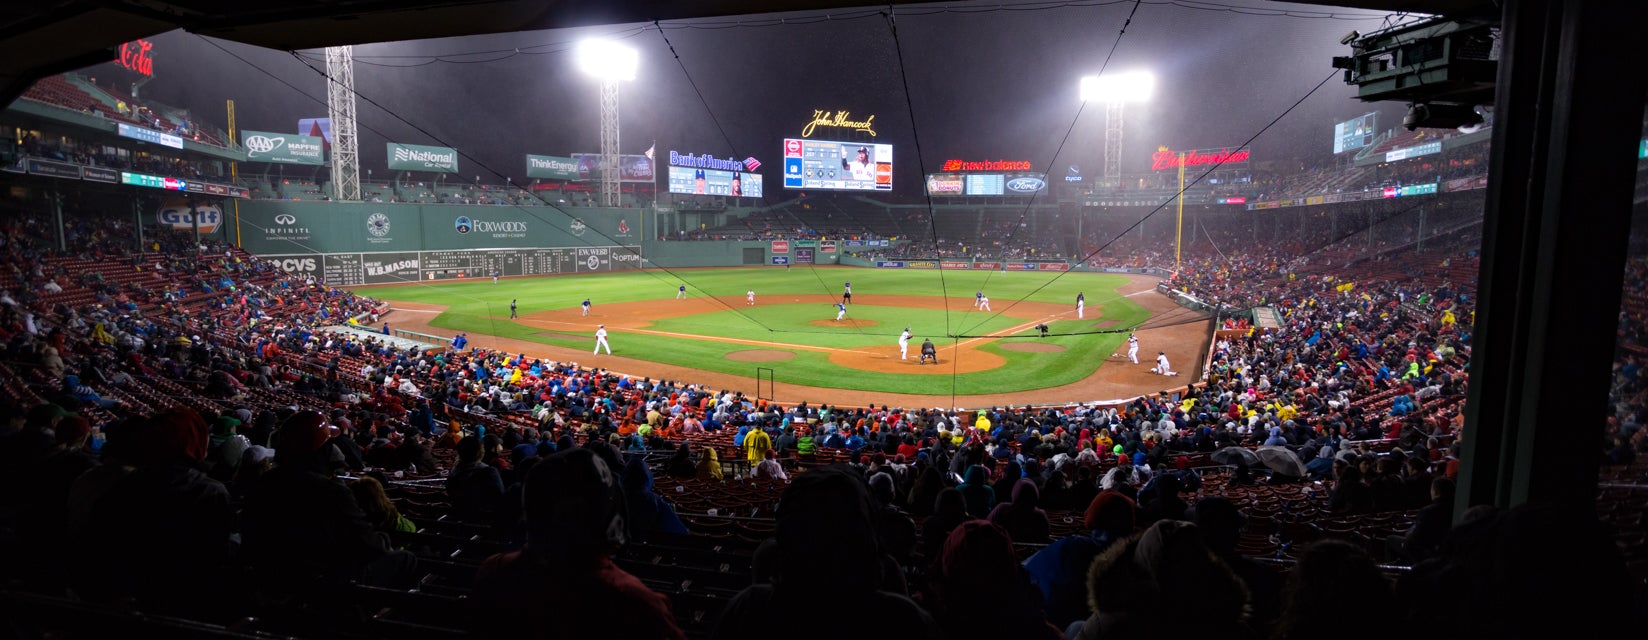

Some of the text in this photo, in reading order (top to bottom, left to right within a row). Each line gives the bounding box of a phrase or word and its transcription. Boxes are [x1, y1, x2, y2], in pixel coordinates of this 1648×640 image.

[802, 109, 876, 137] John Hancock
[409, 150, 452, 163] National
[670, 150, 743, 171] Bank of America
[1152, 147, 1250, 171] Budweiser
[530, 158, 578, 173] ThinkEnergy
[962, 159, 1031, 170] new balance
[1014, 179, 1037, 190] Ford
[162, 209, 218, 224] Gulf
[473, 219, 527, 232] FOXWOODS
[282, 258, 316, 272] CVS
[618, 254, 640, 262] OPTUM
